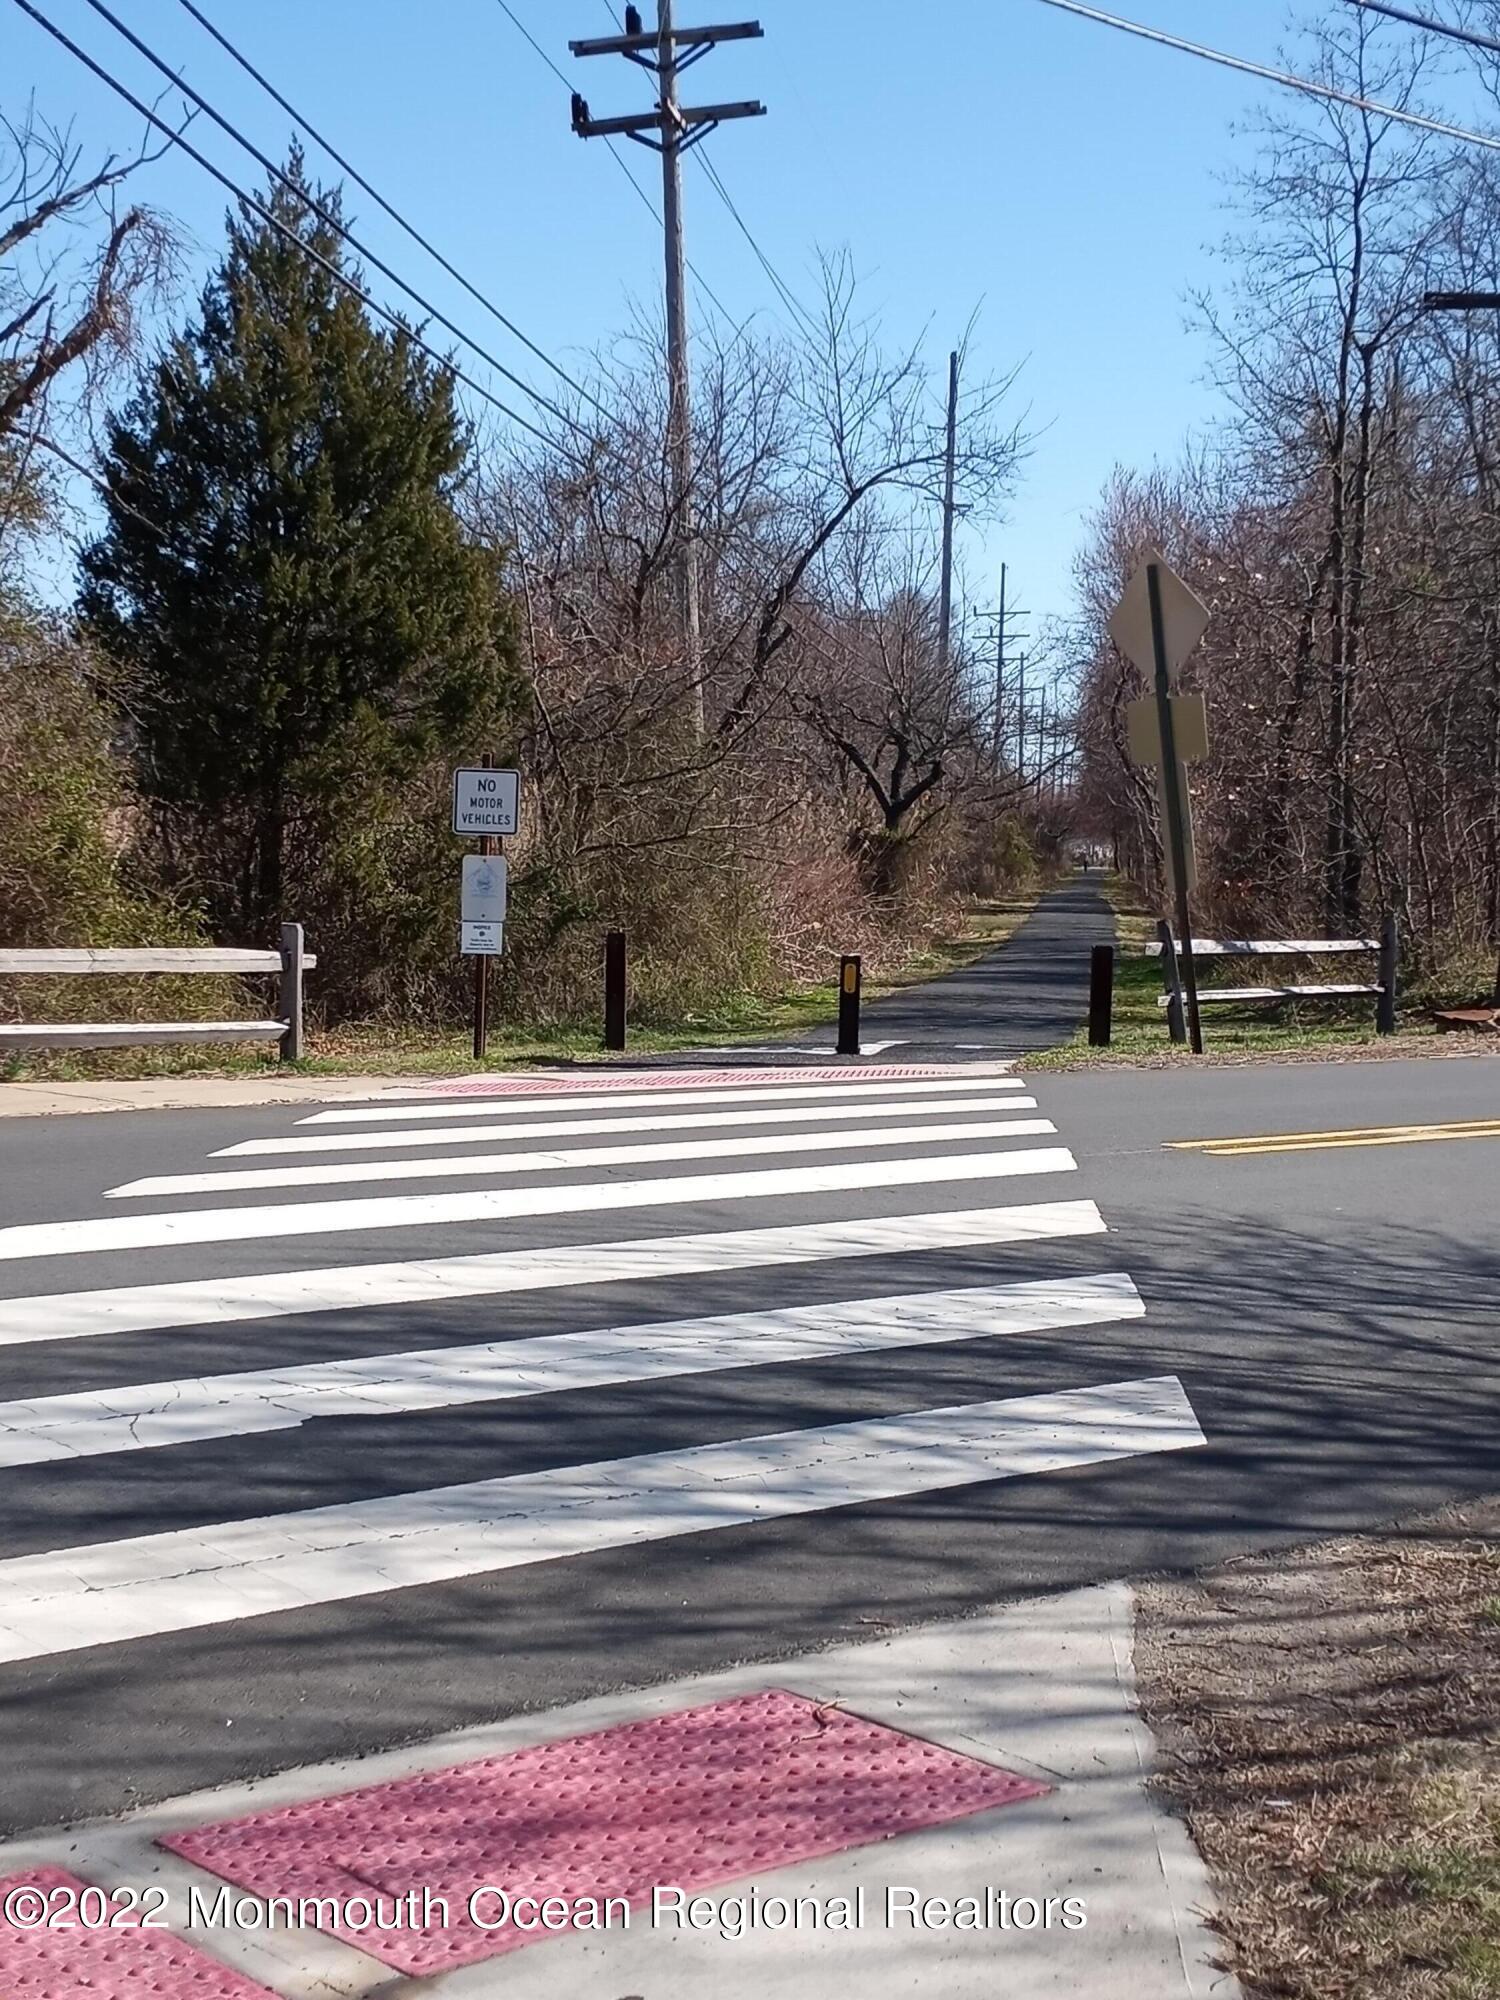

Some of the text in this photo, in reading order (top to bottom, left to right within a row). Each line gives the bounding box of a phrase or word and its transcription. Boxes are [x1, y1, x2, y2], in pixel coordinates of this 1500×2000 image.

[477, 779, 497, 792] NO
[470, 797, 503, 809] MOTOR
[462, 813, 511, 826] VEHICLES
